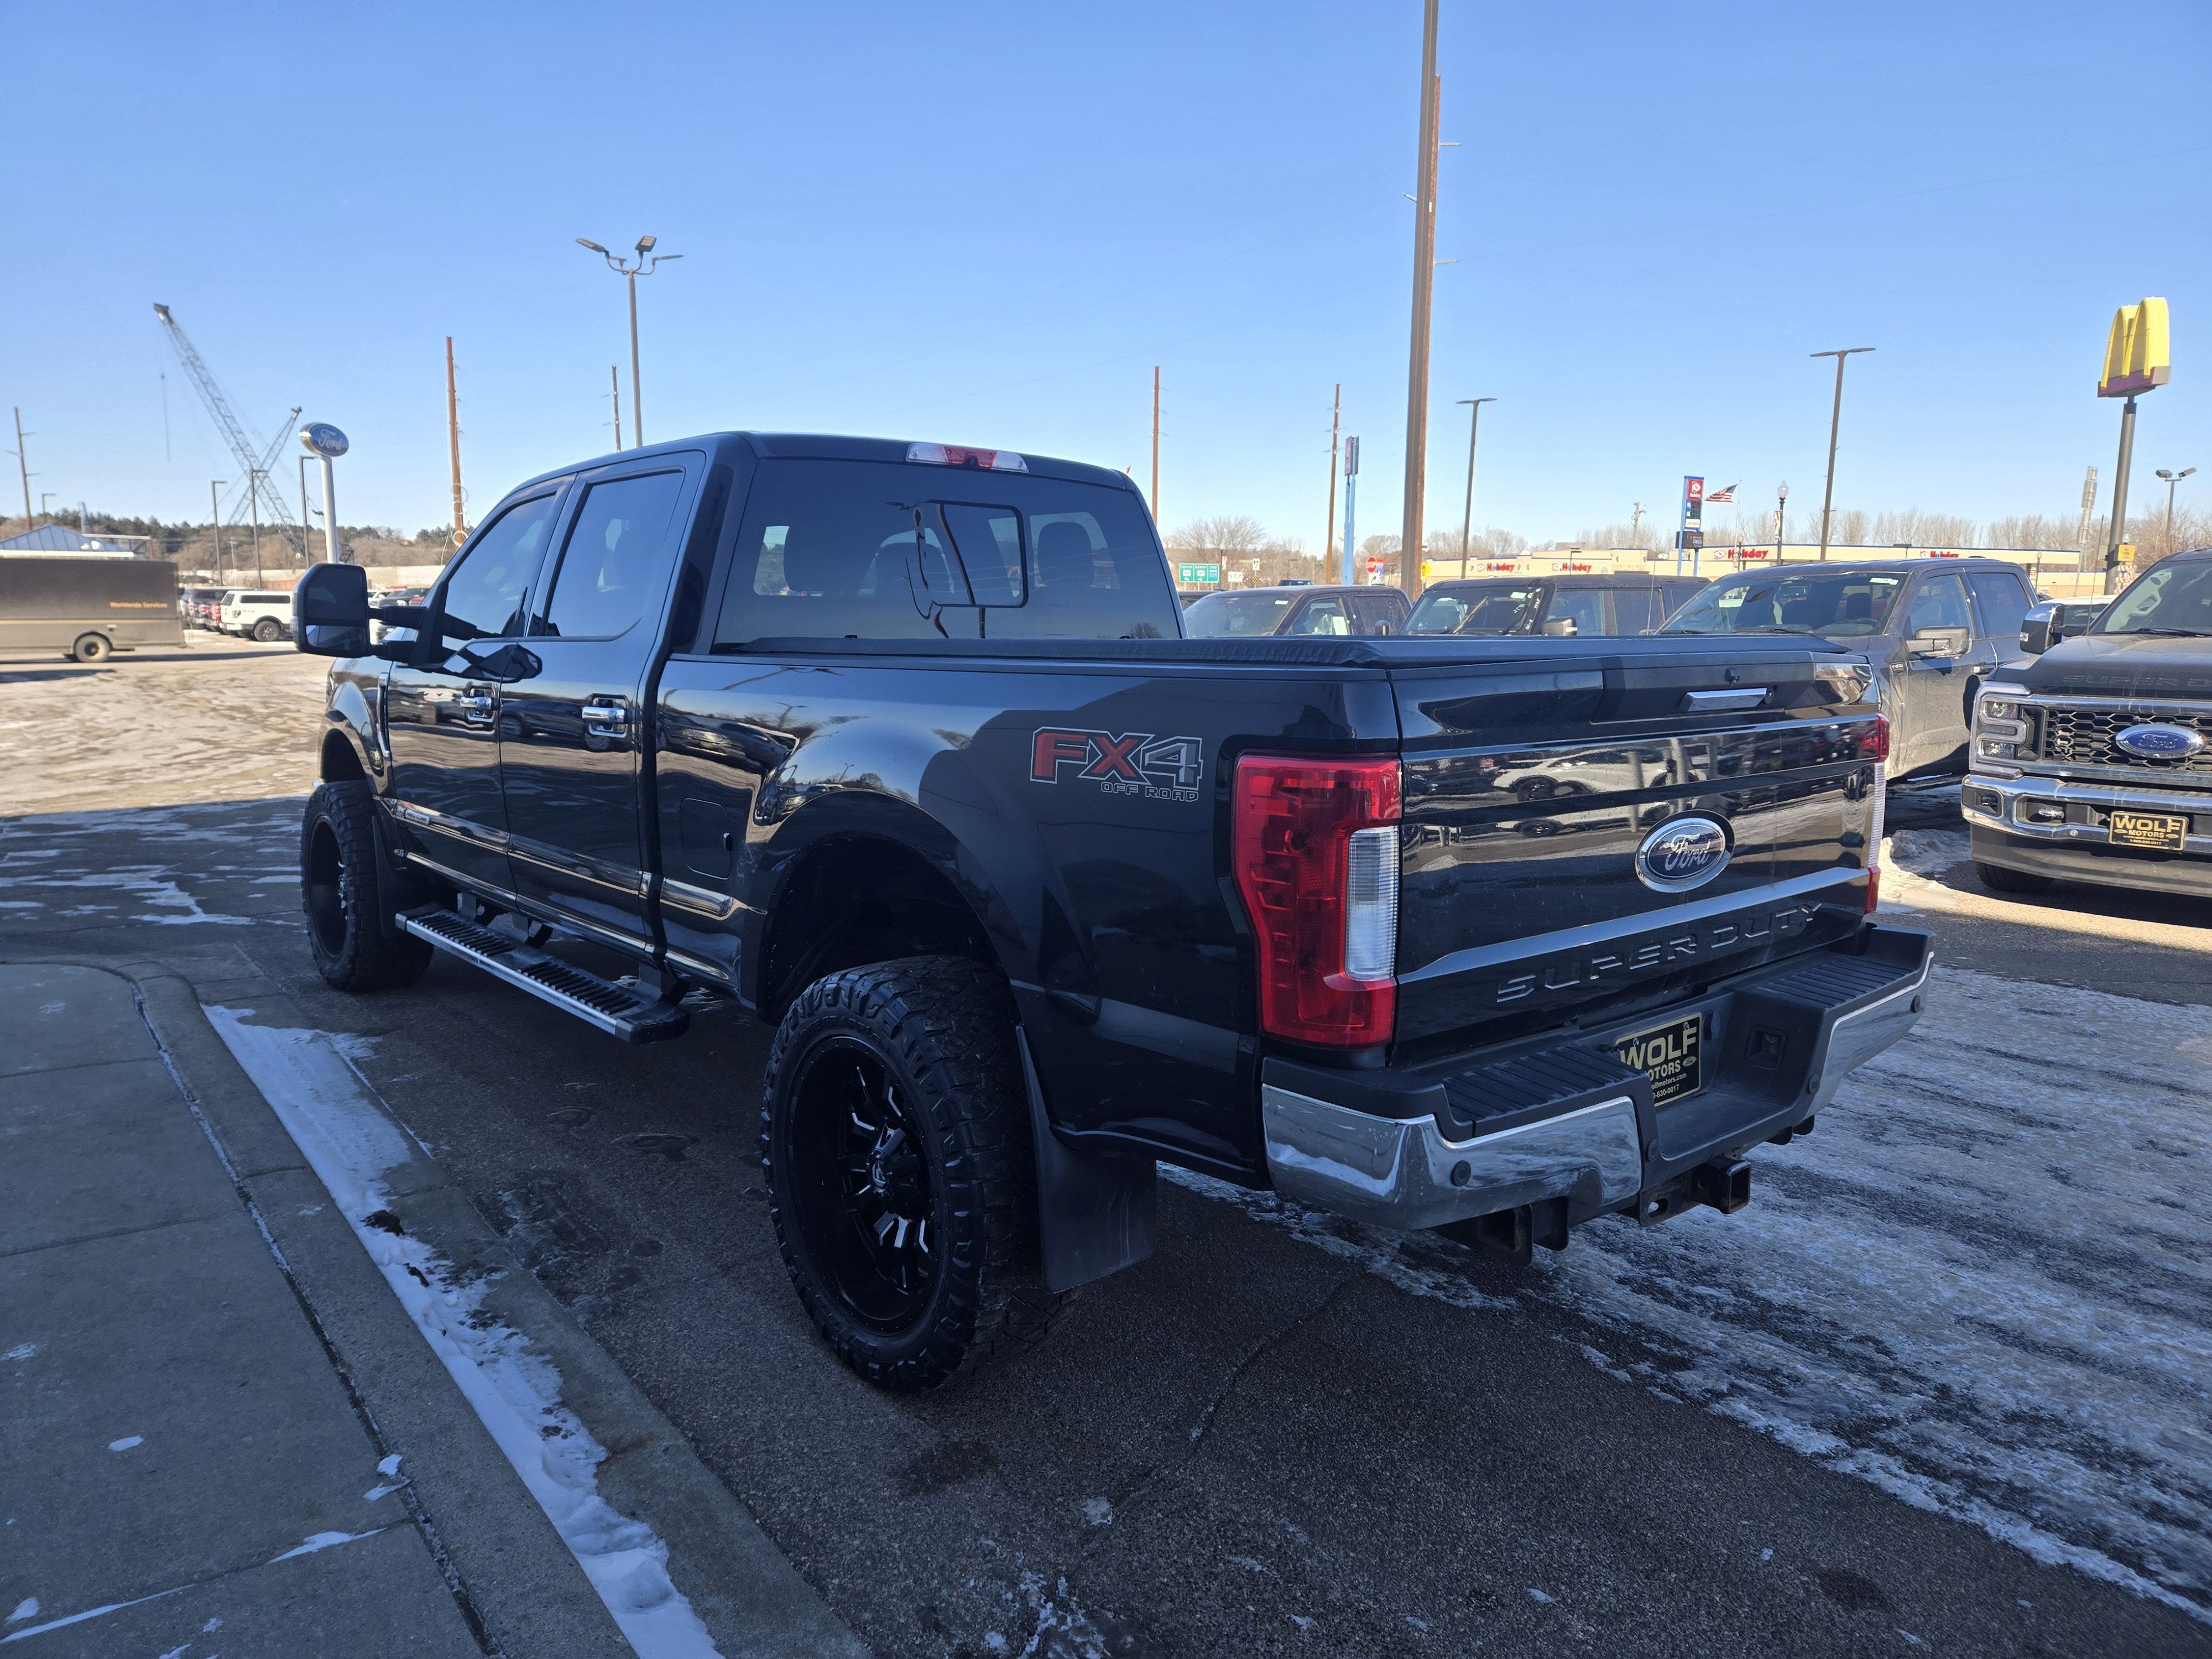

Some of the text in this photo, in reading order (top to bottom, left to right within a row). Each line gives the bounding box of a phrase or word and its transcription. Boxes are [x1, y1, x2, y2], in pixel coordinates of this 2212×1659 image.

[319, 429, 342, 451] Ford
[1728, 549, 1768, 559] Hliday
[2063, 675, 2180, 686] SUPER
[2138, 733, 2178, 749] Ford
[1030, 726, 1204, 790] FX4
[1100, 781, 1199, 802] OFF ROAD
[2115, 817, 2181, 833] WOLF
[2128, 830, 2165, 838] MOTORS
[1665, 833, 1712, 871] Ford
[1496, 901, 1822, 1003] SUPER DUTY
[1620, 1026, 1697, 1070] WOLF
[1646, 1060, 1681, 1081] OTORS
[1651, 1073, 1687, 1089] olfmotors.com
[1653, 1084, 1679, 1099] -830-0017
